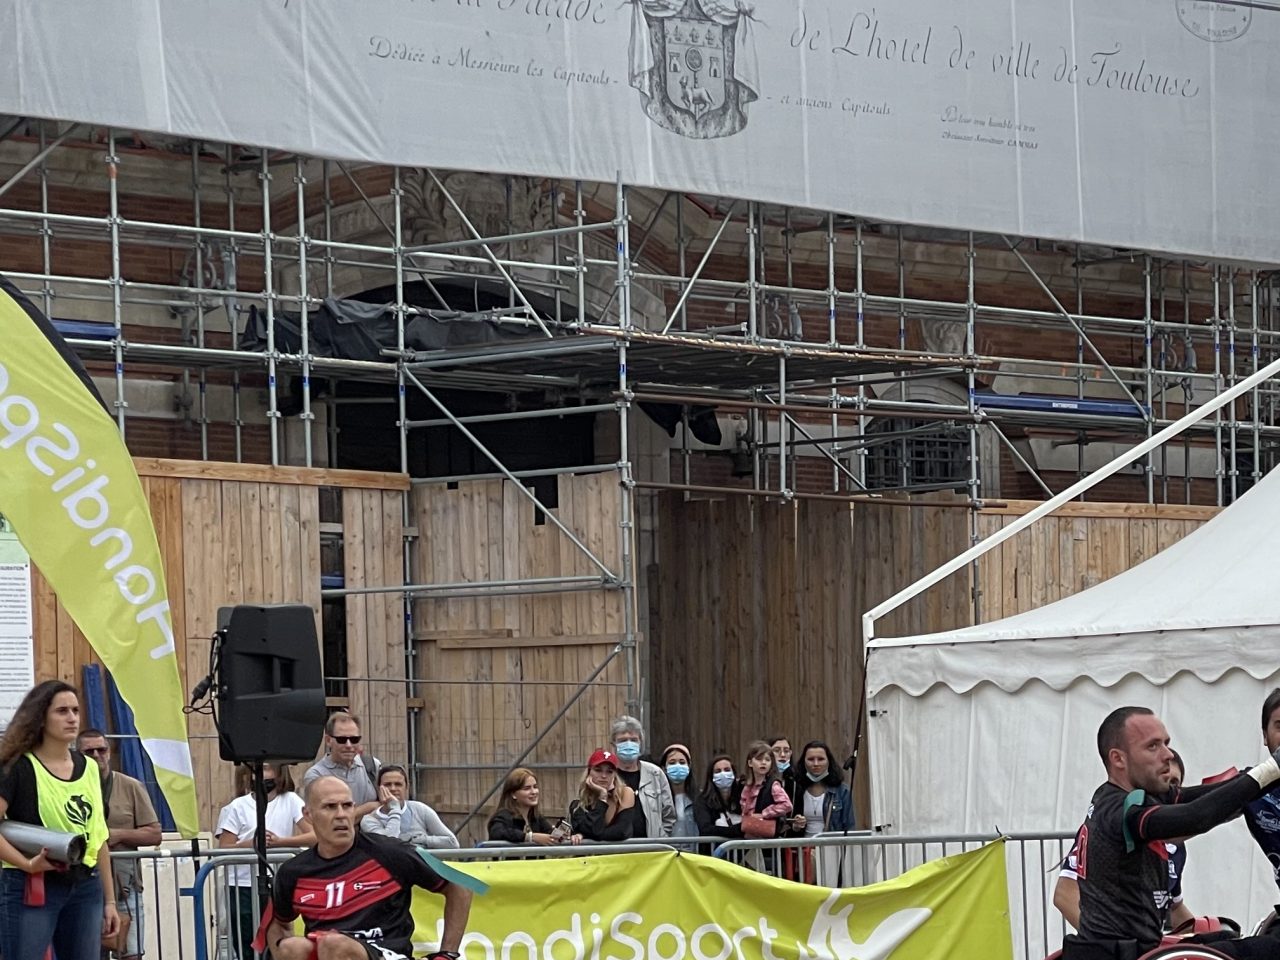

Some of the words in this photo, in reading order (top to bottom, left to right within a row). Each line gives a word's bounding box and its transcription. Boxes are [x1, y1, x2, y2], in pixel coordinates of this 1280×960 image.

[448, 47, 519, 74] Messieurs
[526, 59, 543, 77] les
[841, 98, 891, 117] Capitouls
[498, 0, 606, 32] açade
[790, 9, 820, 51] de
[949, 25, 975, 70] de
[992, 41, 1040, 80] ville
[1054, 46, 1078, 84] de
[1087, 42, 1199, 98] Toulouse
[325, 880, 346, 910] 11
